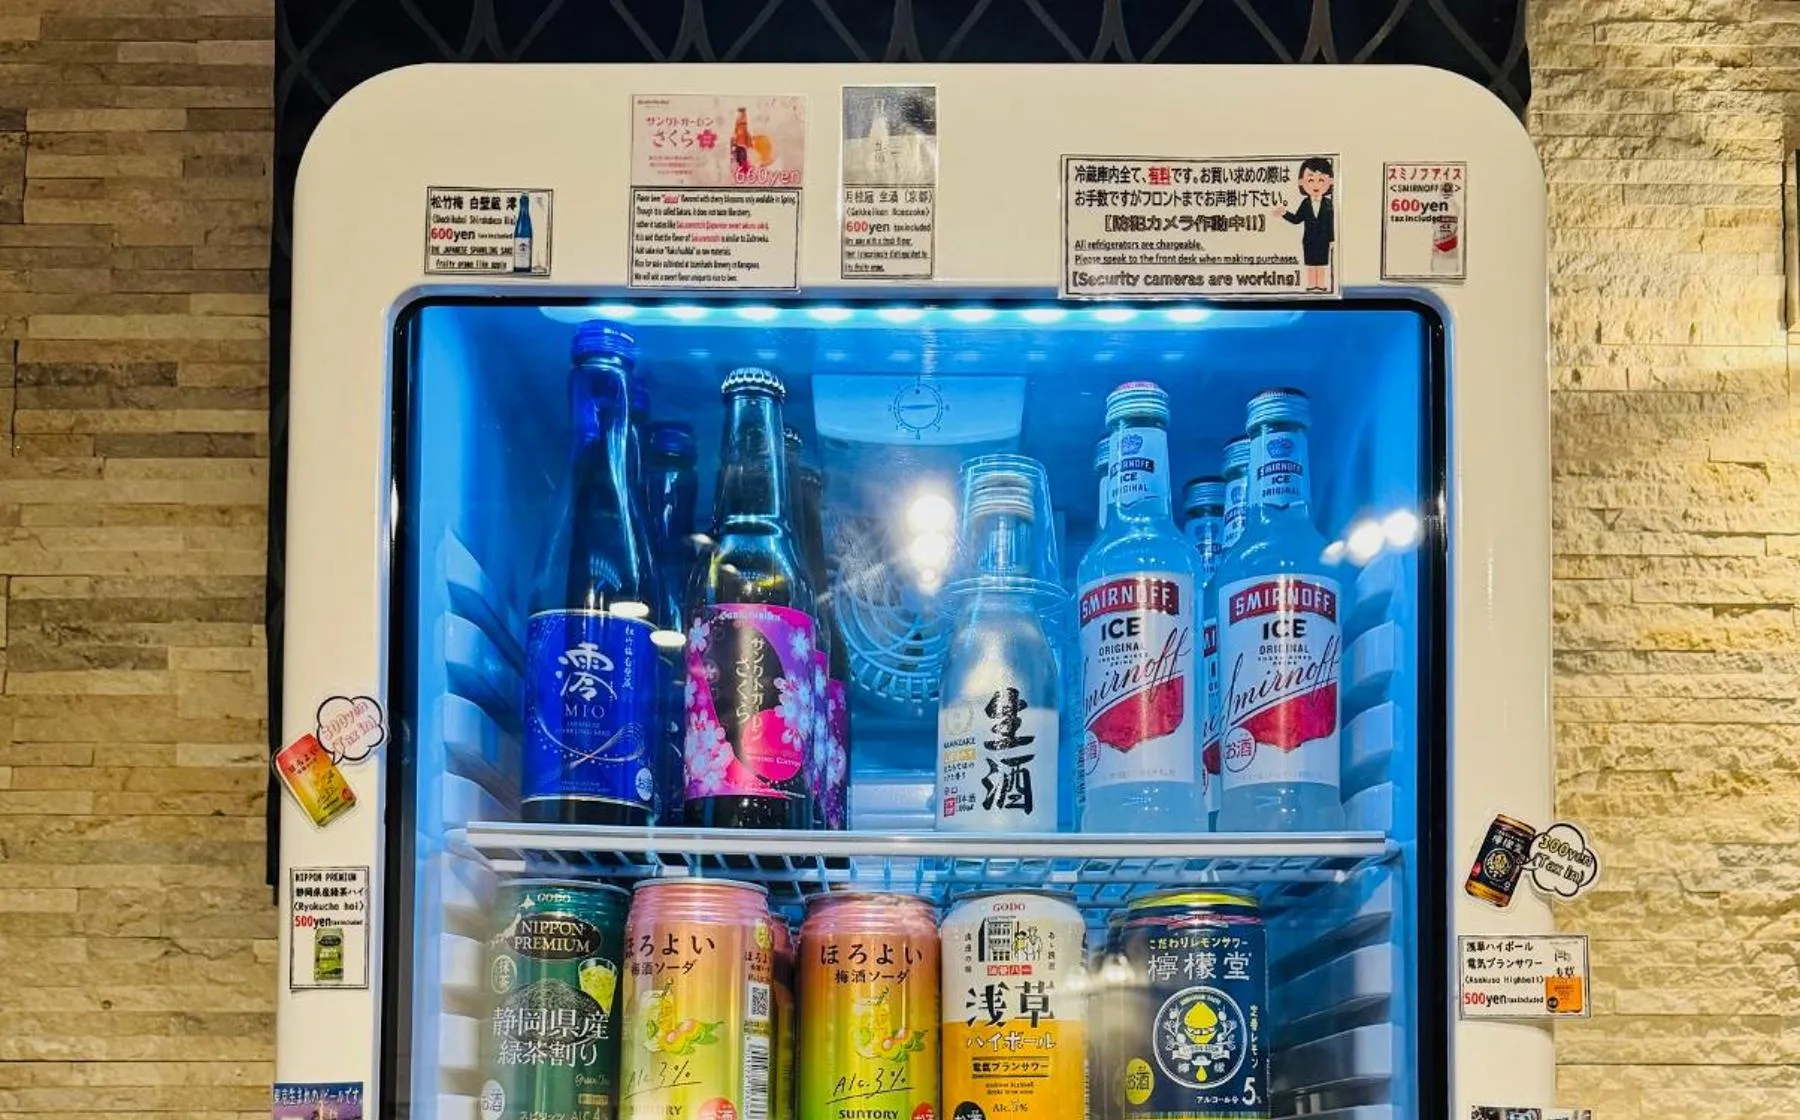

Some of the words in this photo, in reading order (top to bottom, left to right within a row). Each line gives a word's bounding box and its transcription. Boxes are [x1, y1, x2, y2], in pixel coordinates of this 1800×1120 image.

[653, 129, 694, 148] さくら
[735, 168, 801, 186] 660yen
[1388, 167, 1462, 181] スミノフアイス
[431, 195, 464, 211] 松竹梅
[1391, 199, 1449, 215] 600yen
[431, 228, 476, 243] 600yen
[846, 221, 890, 235] 600yen
[1088, 239, 1139, 251] refrigerators
[1141, 241, 1154, 250] are
[1102, 255, 1127, 266] speak
[1128, 255, 1138, 264] to
[1140, 255, 1153, 264] the
[1155, 255, 1176, 264] front
[1178, 255, 1197, 264] desk
[1199, 256, 1222, 264] when
[1224, 255, 1254, 266] making
[1143, 273, 1205, 287] cameras
[1208, 274, 1233, 287] are
[1271, 474, 1291, 485] ICE
[1101, 616, 1142, 641] ICE
[1262, 619, 1308, 641] ICE
[564, 703, 606, 719] MIO
[1225, 738, 1252, 760] お酒
[295, 872, 322, 882] NIPPON
[325, 872, 357, 882] PREMIUM
[992, 903, 1026, 912] GODO
[295, 915, 331, 930] 500yen
[521, 920, 585, 937] NIPPON
[513, 936, 591, 954] PREMIUM
[1149, 936, 1249, 950] こだわりレモンサワー
[1466, 941, 1534, 952] 浅草ハイボール
[820, 943, 923, 966] ほろよい
[1148, 951, 1250, 982] 檸檬堂
[835, 969, 911, 985] 梅酒ソーダ
[965, 980, 1055, 1029] 浅草
[1464, 991, 1507, 1008] 500yen
[492, 1004, 610, 1041] 静岡県産
[965, 1031, 1057, 1051] ハイボール
[496, 1041, 598, 1068] 緑茶割り
[838, 1109, 899, 1120] SUNTORY
